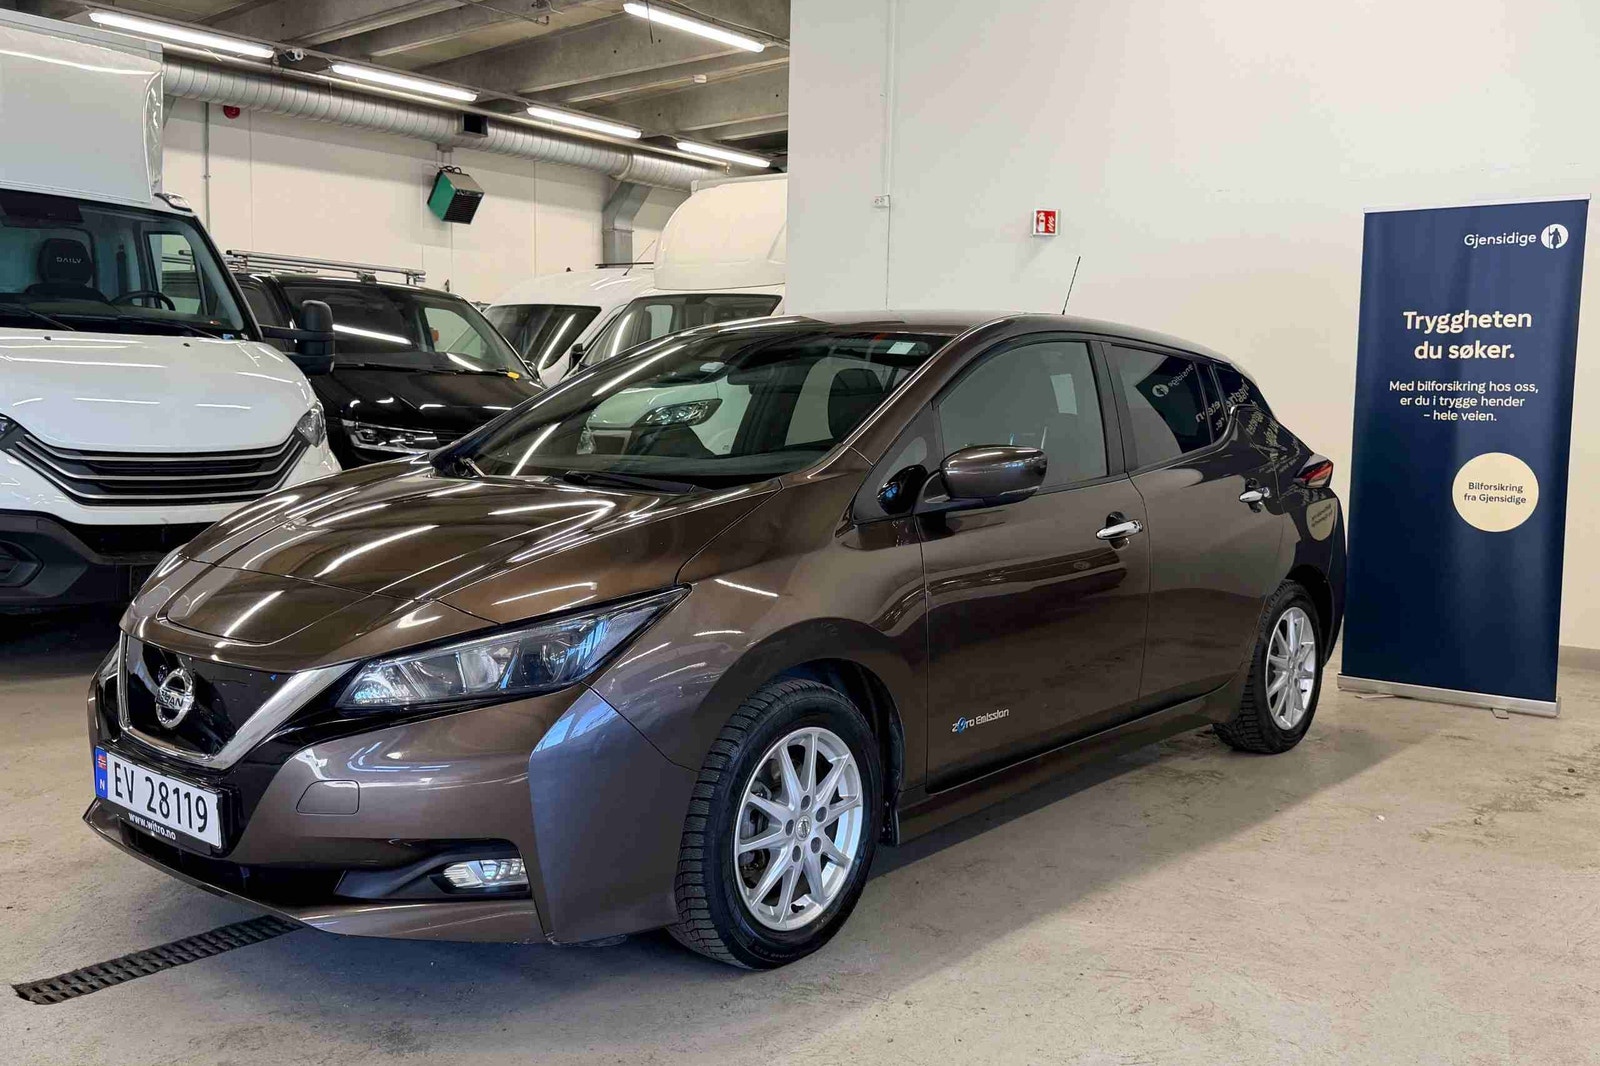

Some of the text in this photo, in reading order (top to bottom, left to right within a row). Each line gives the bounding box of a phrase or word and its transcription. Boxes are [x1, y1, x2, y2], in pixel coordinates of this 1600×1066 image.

[1463, 231, 1537, 249] Gjensidige
[1403, 310, 1533, 335] Tryggheten
[1414, 340, 1516, 360] du søker.
[1389, 379, 1540, 394] Med bilforsikring hos oss,
[1400, 395, 1526, 409] er du i trygge hender
[1433, 410, 1459, 421] hele
[1461, 410, 1498, 422] veien.
[1468, 482, 1524, 494] Bilforsikring
[1464, 493, 1527, 505] fra Gjensidige
[156, 688, 184, 707] SSAN
[975, 708, 1010, 725] Emission
[99, 778, 106, 792] N
[114, 761, 209, 833] EV 28119
[128, 812, 177, 841] www.witro.no
